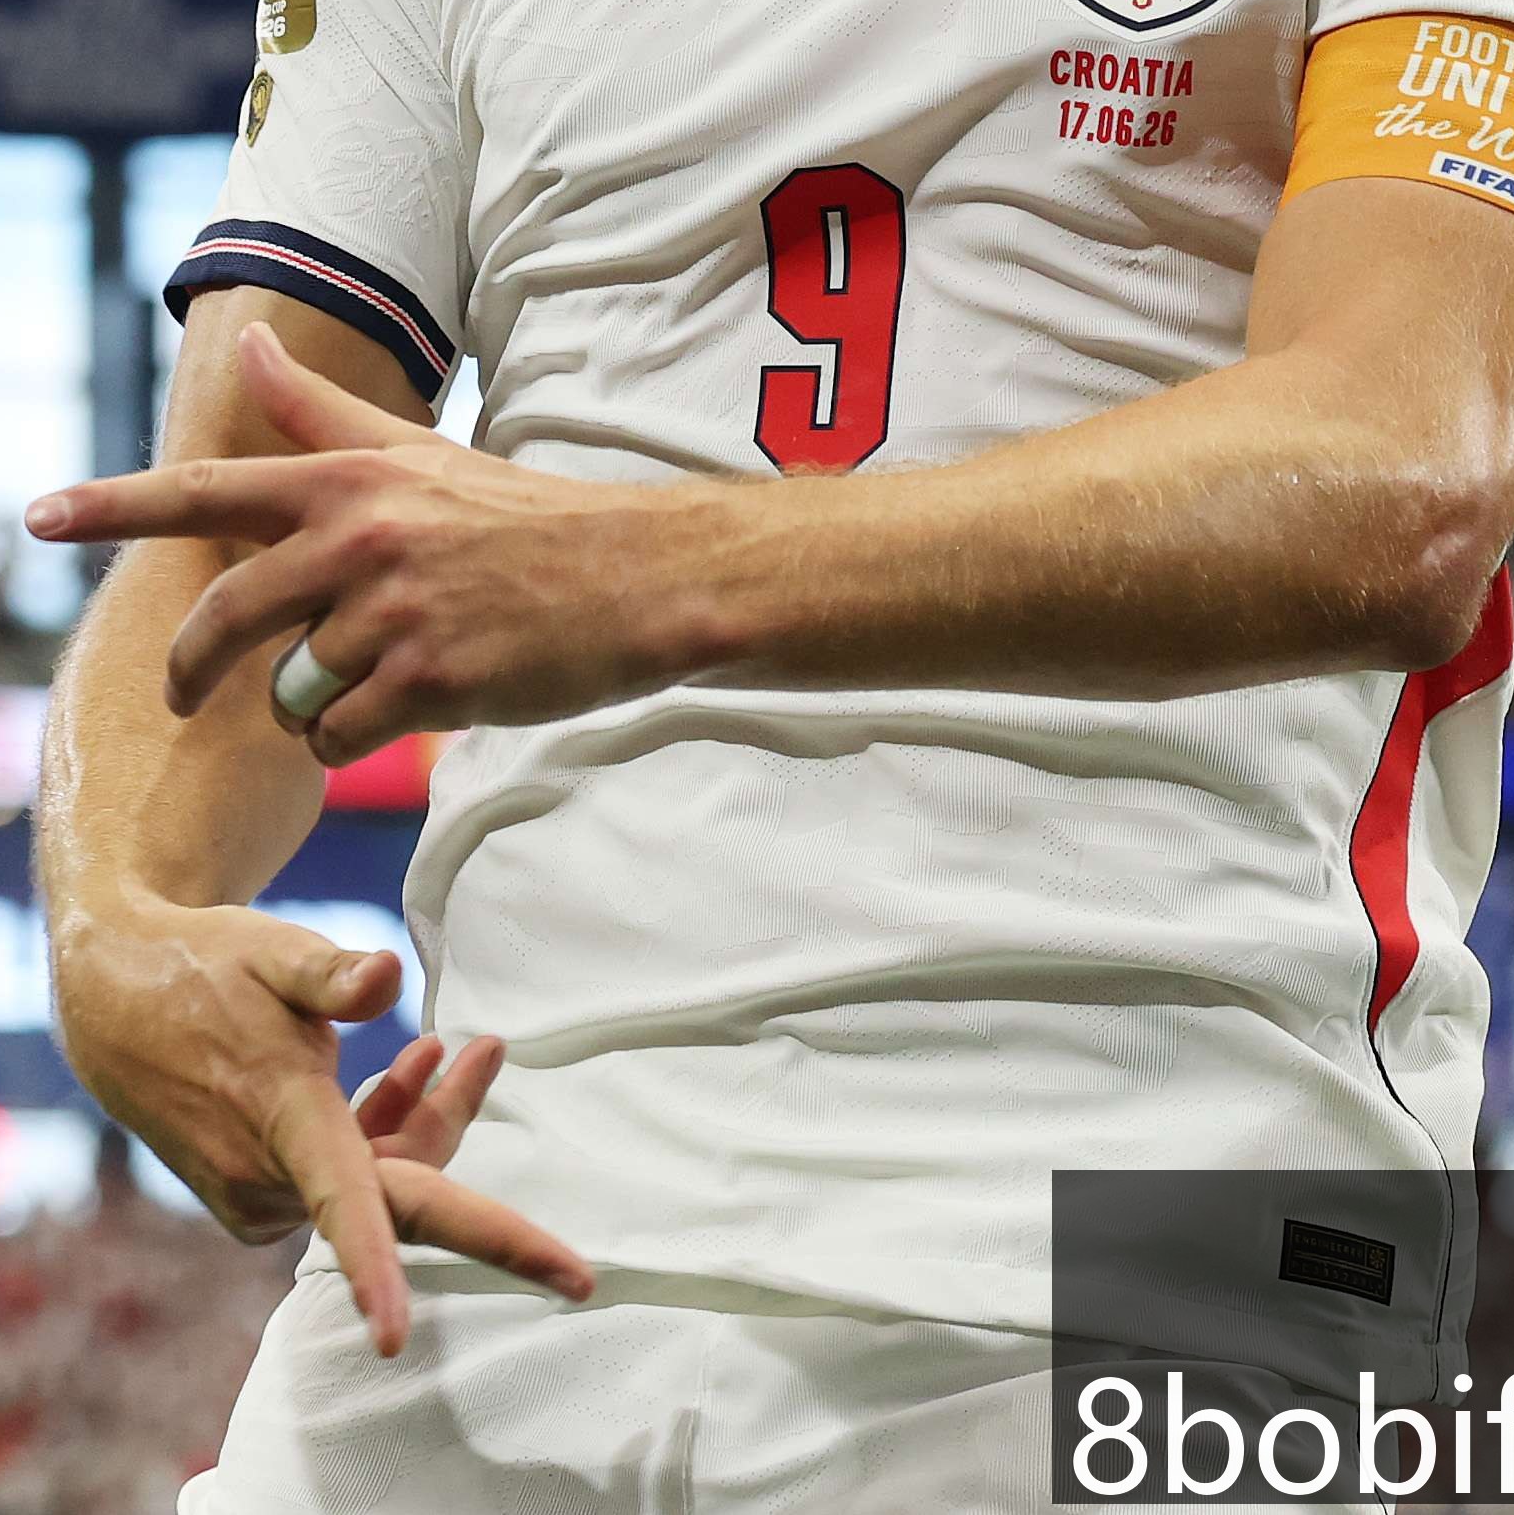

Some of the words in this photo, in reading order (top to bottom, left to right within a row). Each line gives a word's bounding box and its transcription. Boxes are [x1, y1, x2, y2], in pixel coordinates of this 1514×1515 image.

[1049, 49, 1193, 97] CROATIA
[1059, 99, 1177, 148] 17.06.26
[1374, 101, 1461, 140] the
[753, 162, 906, 477] 9
